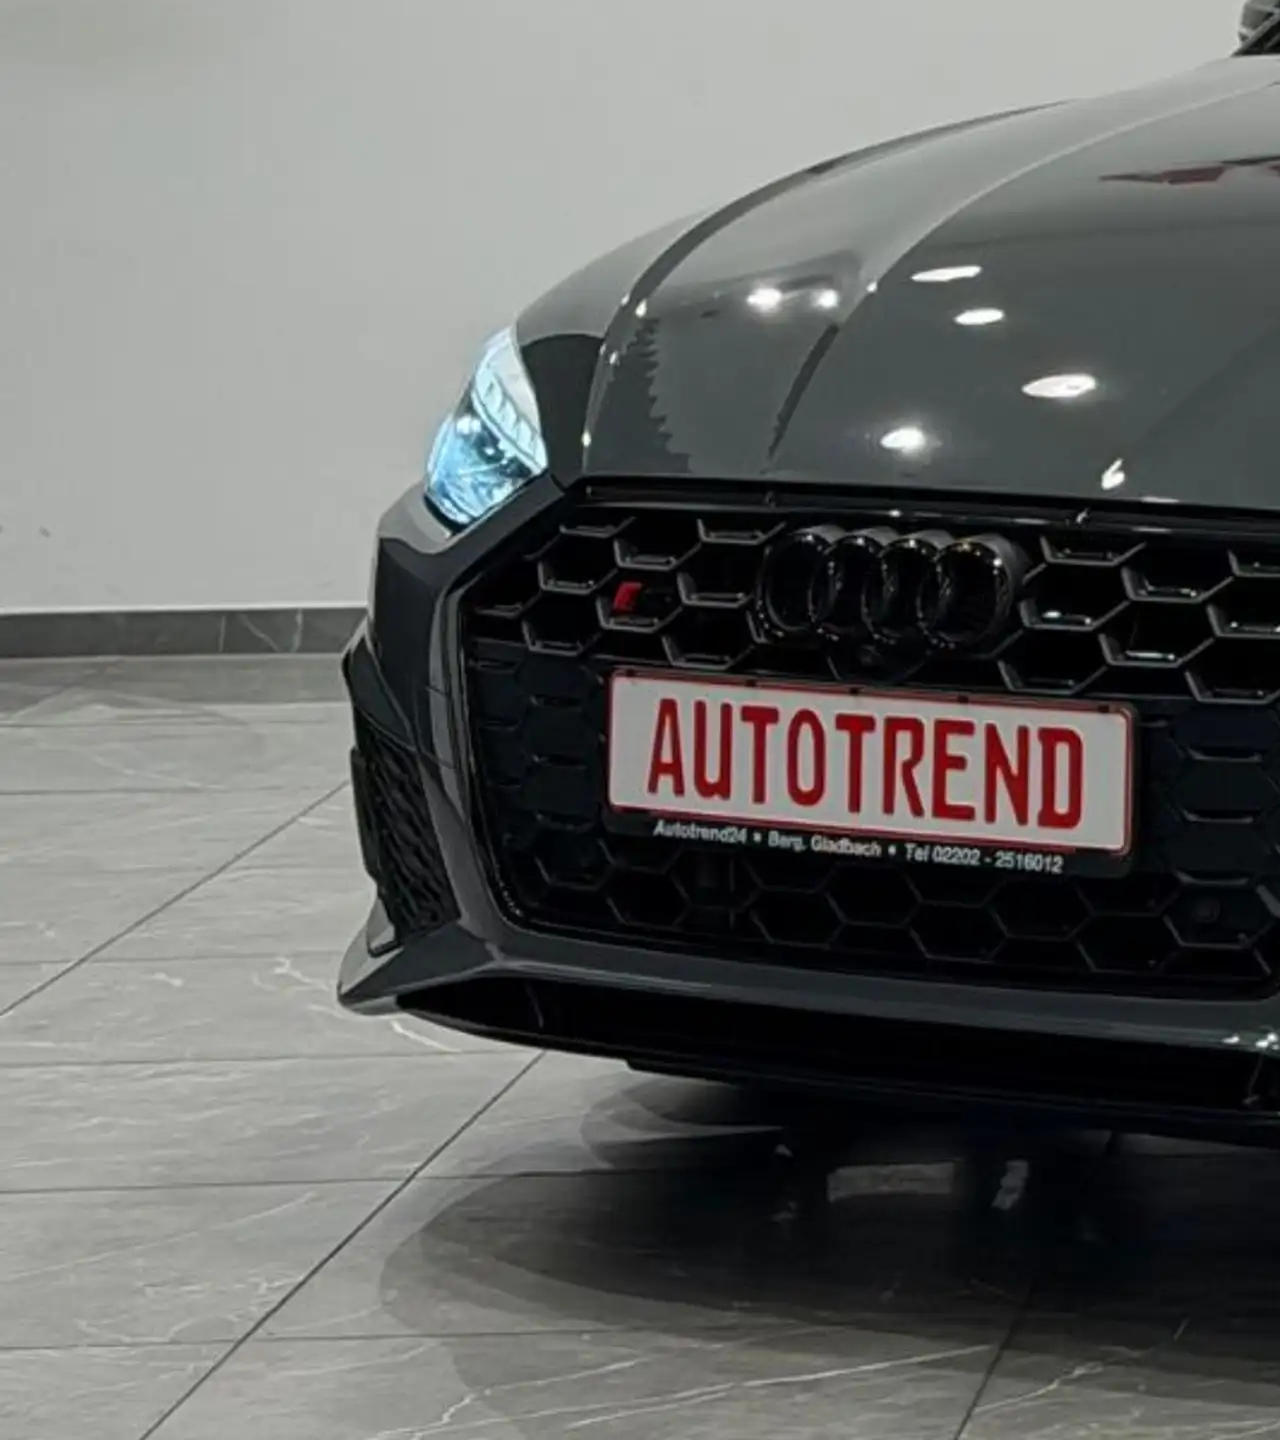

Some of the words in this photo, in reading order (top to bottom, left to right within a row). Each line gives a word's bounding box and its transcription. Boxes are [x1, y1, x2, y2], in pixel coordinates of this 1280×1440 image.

[646, 697, 1084, 830] AUTOTREND
[653, 819, 748, 845] Autotrend24
[811, 835, 882, 858] Gladbach
[904, 843, 928, 862] Tel
[933, 846, 981, 866] 02202
[995, 853, 1064, 874] 2516012
